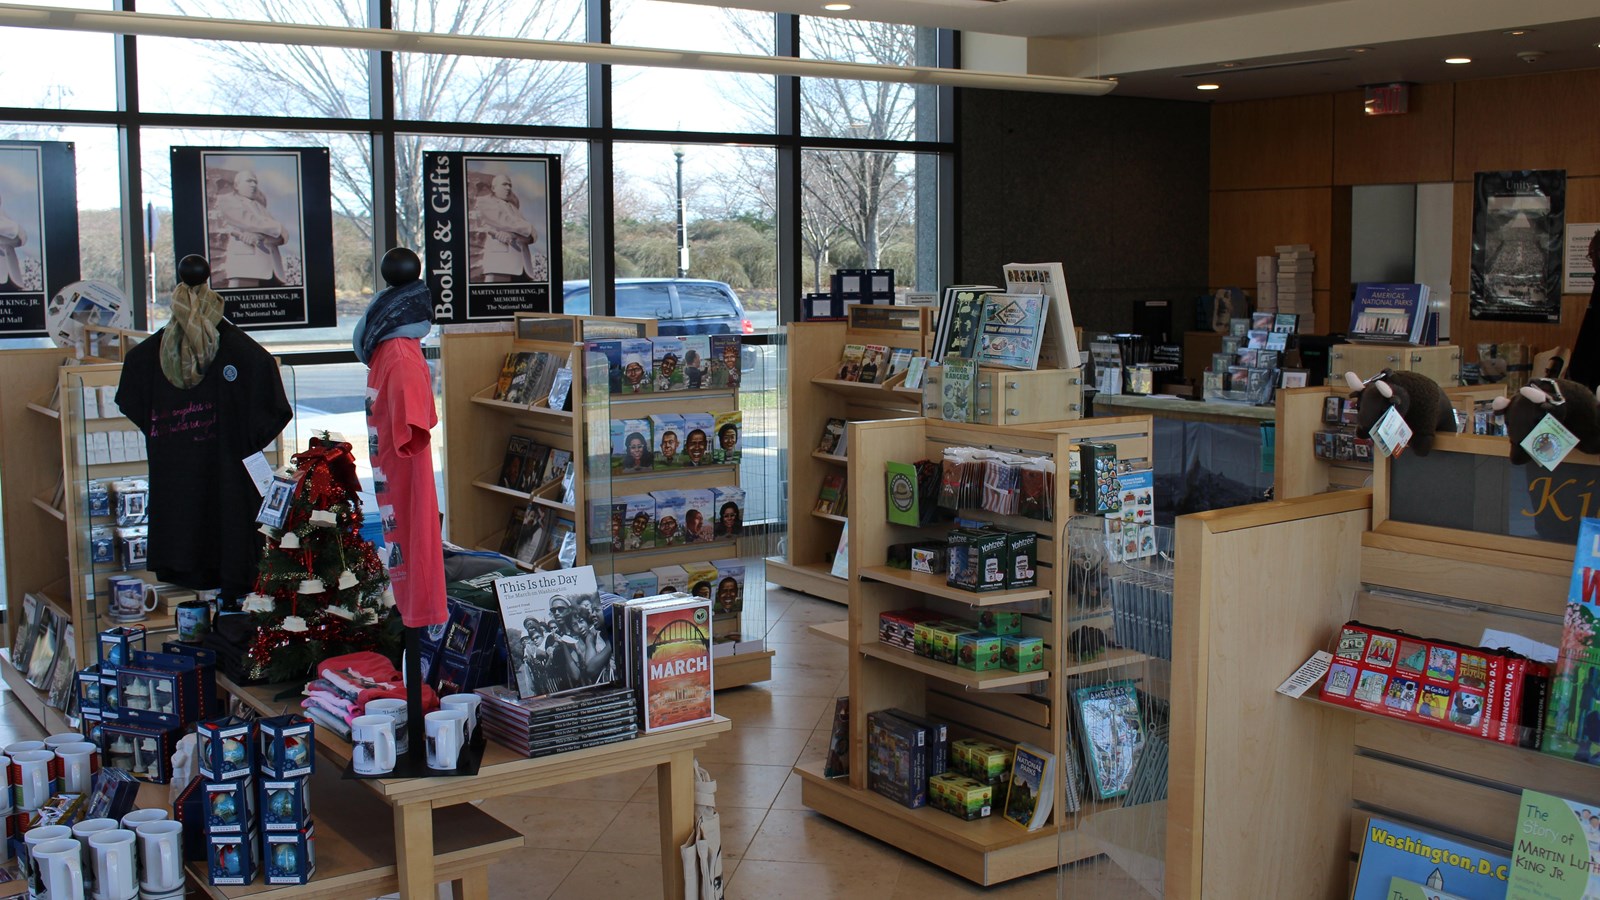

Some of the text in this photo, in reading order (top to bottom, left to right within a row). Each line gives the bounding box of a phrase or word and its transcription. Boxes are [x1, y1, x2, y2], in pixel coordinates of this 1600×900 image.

[1506, 180, 1532, 190] Unity
[429, 155, 453, 320] Books & Gifts
[1361, 298, 1393, 306] NATIONAL
[1371, 291, 1404, 299] AMERICA'S
[1520, 477, 1600, 522] Ki
[948, 535, 967, 543] Yahtzee
[981, 541, 1006, 553] Yahtzee
[1011, 537, 1034, 550] Yahtzee
[500, 574, 578, 594] This Is the Day
[515, 591, 531, 599] March
[538, 586, 567, 596] Washington
[650, 655, 707, 680] MARCH
[1090, 686, 1126, 700] AMERICA'S
[1481, 661, 1498, 737] WASHINGTON, D.C.
[1498, 663, 1516, 741] WASHINGTON, D.C.
[1017, 755, 1042, 773] NATIONAL
[1020, 764, 1036, 776] PARKS
[1526, 804, 1549, 821] The
[1523, 819, 1575, 846] Story of
[1371, 827, 1509, 882] Washington, D.C.
[1518, 839, 1600, 875] MARTIN LUTH
[1516, 855, 1566, 882] KING JR.
